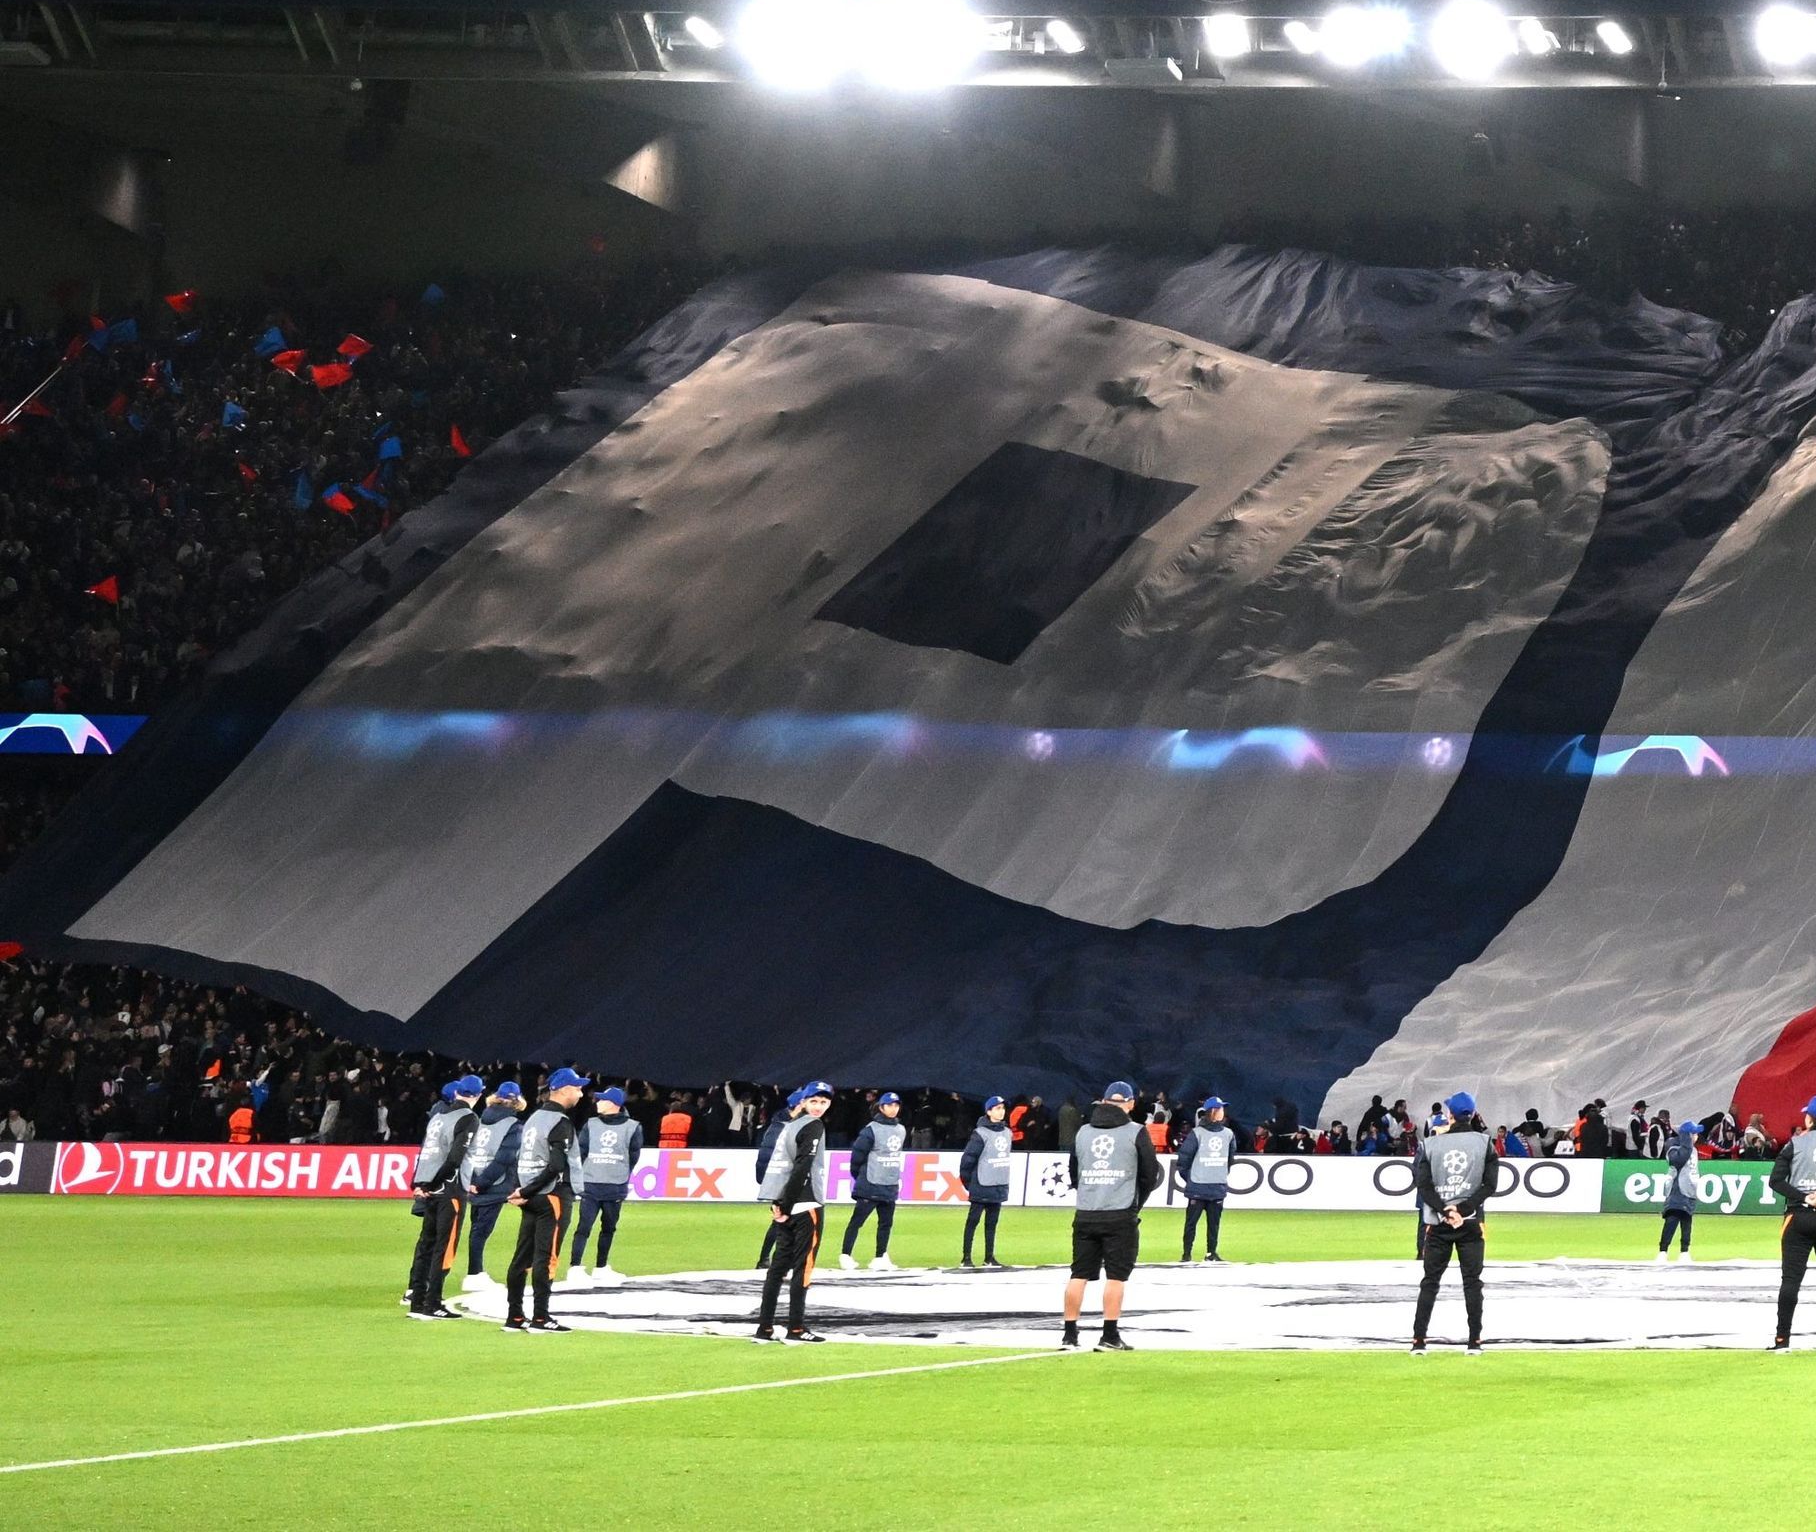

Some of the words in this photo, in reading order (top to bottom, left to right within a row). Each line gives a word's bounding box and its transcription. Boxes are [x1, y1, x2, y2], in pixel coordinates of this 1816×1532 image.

[130, 1151, 322, 1189] TURKISH
[332, 1153, 420, 1191] AIR
[629, 1150, 727, 1199] dEx
[826, 1152, 970, 1201] FdEx
